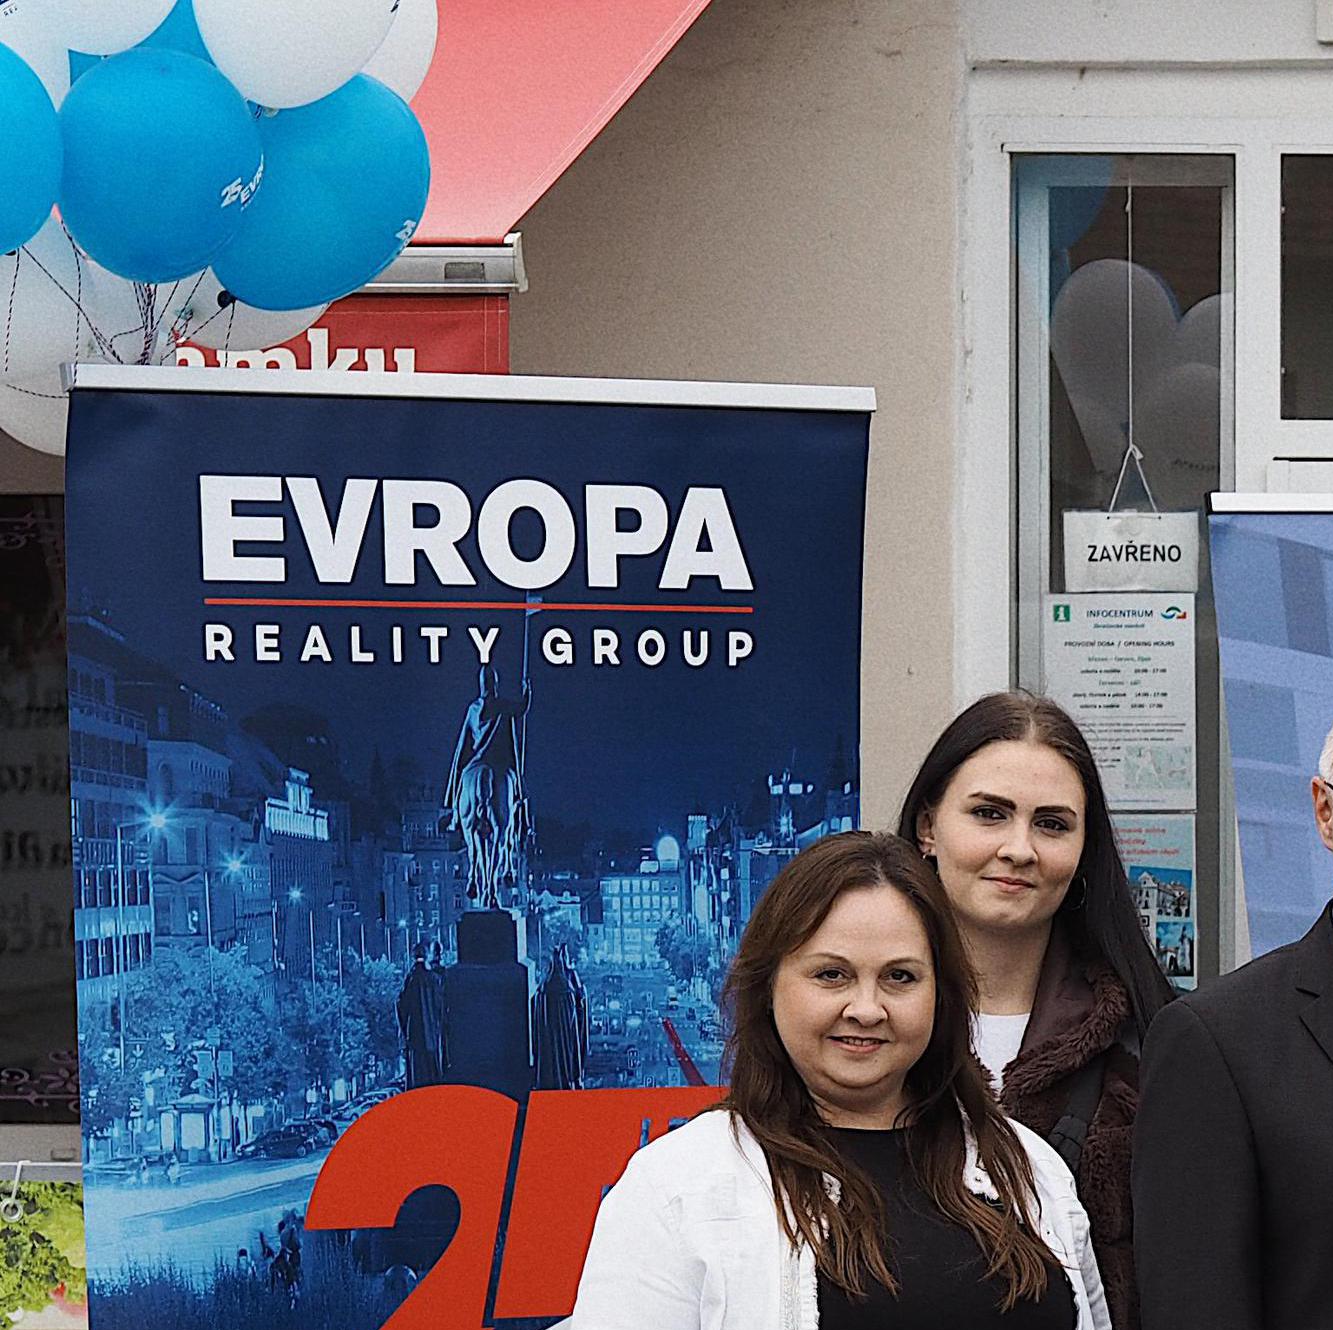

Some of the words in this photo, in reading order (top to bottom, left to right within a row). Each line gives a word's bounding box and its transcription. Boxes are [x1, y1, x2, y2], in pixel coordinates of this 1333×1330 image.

[199, 475, 754, 591] EVROPA
[1087, 540, 1182, 562] ZAVŘENO
[1086, 609, 1153, 618] INFOCENTRUM
[205, 624, 499, 664] REALITY
[541, 628, 754, 666] GROUP
